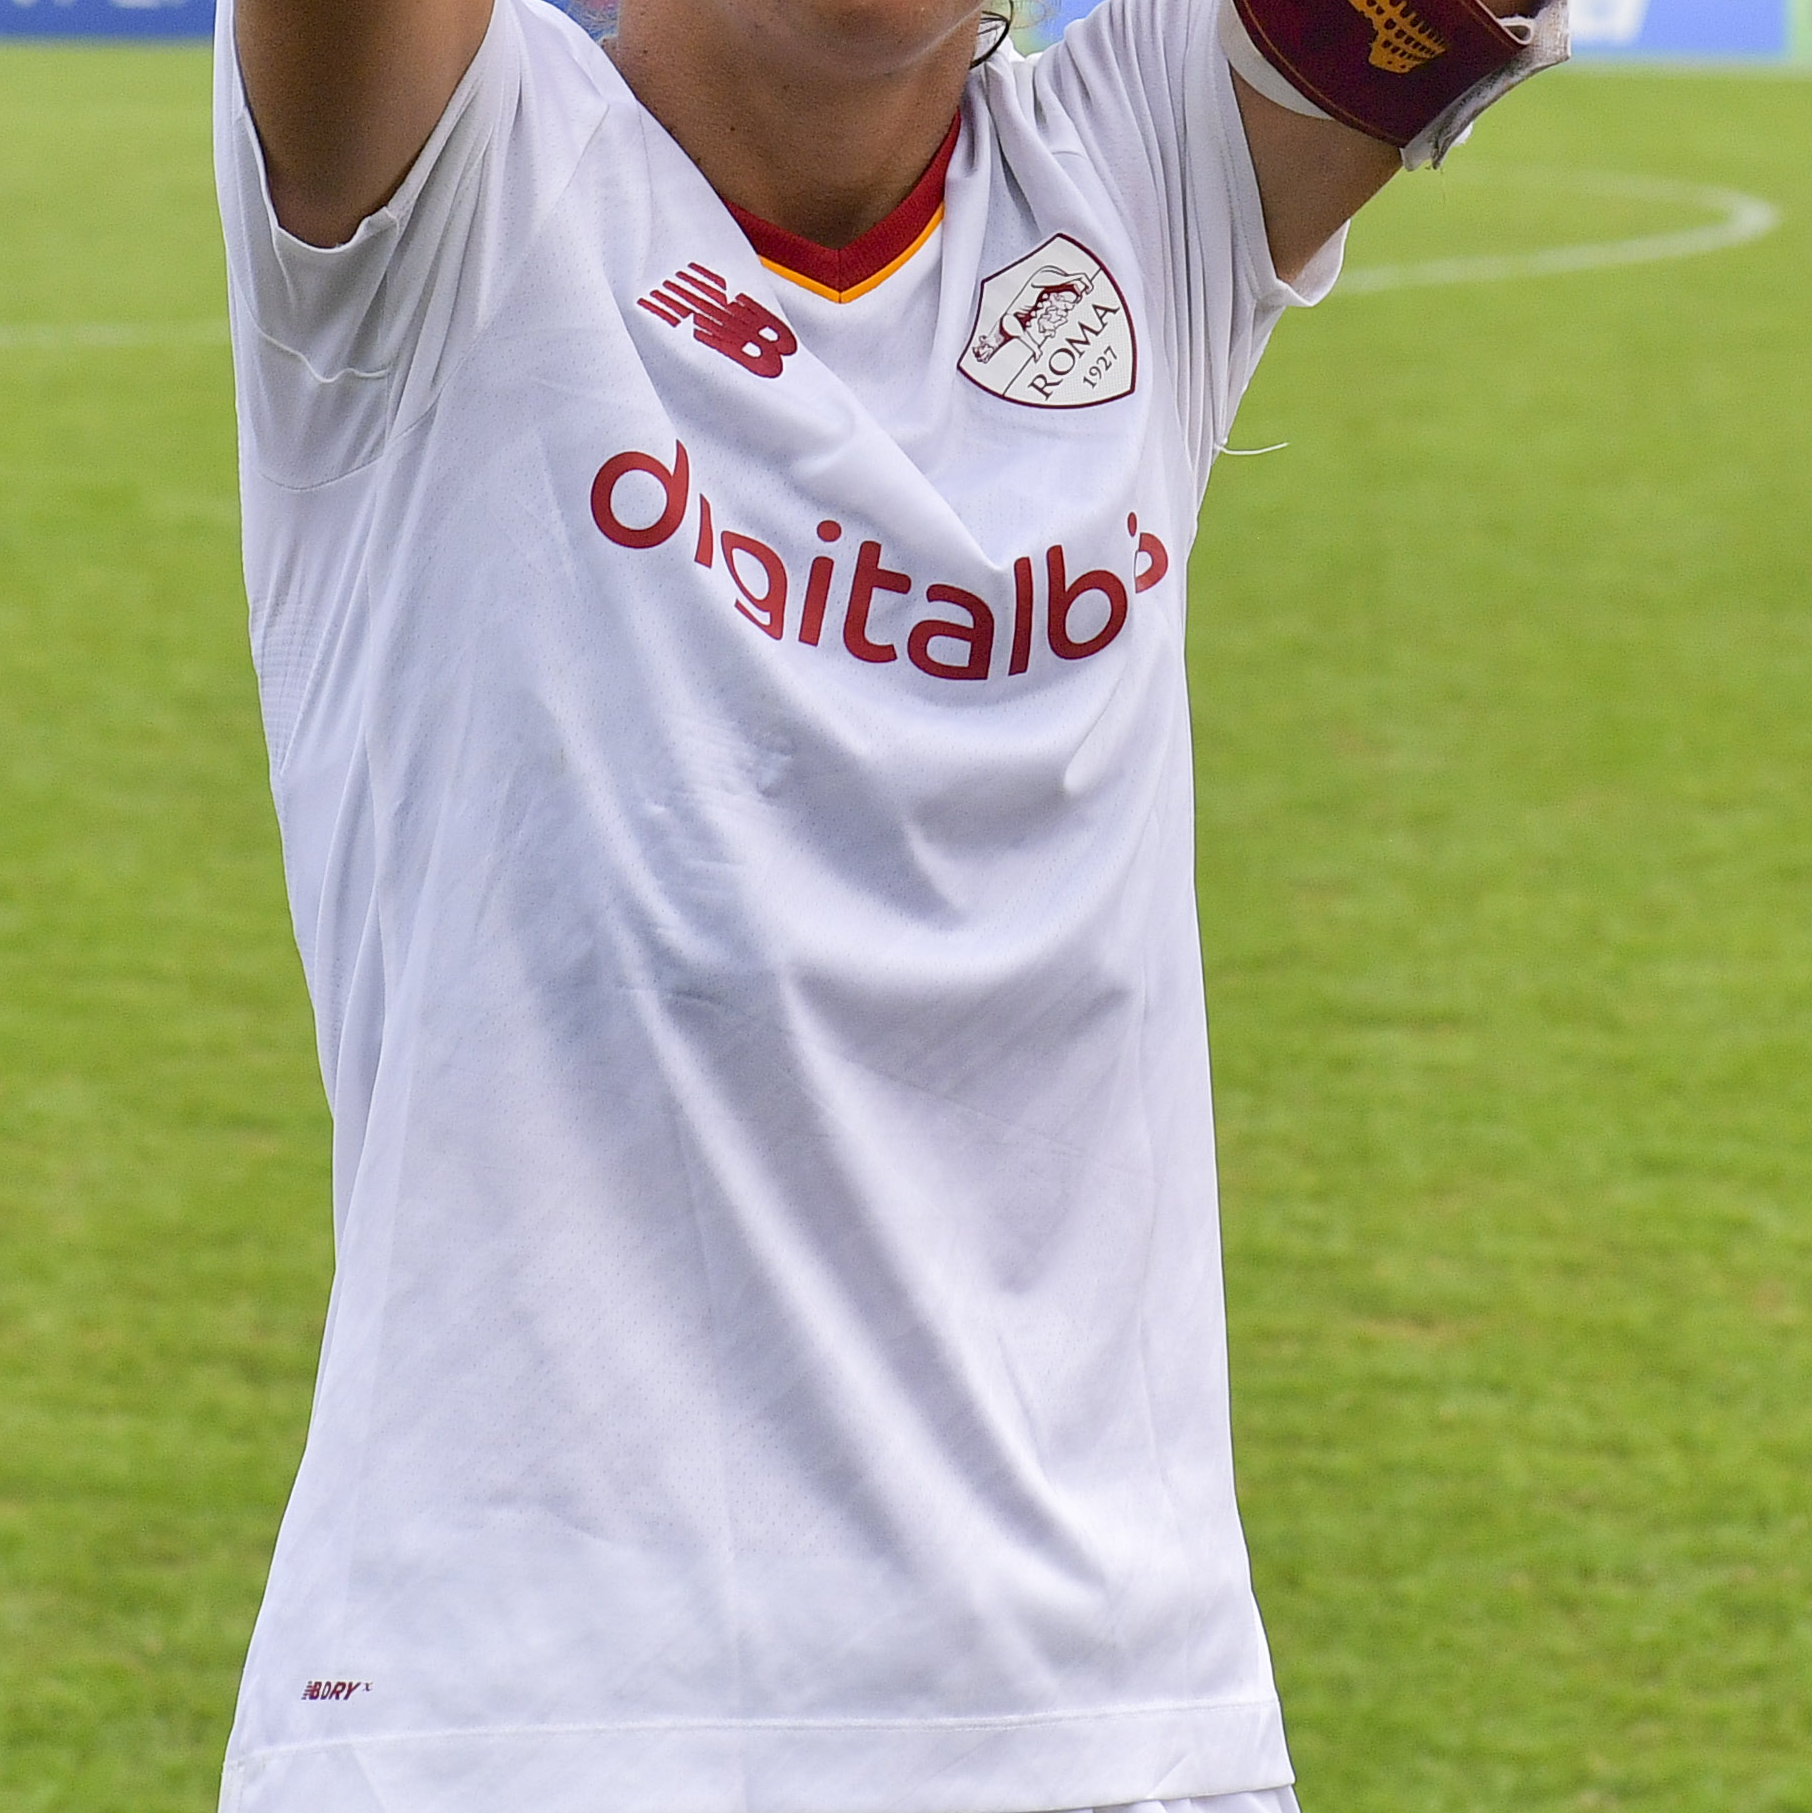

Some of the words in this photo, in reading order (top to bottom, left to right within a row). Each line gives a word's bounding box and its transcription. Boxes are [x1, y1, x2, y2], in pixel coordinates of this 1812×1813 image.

[1027, 303, 1121, 401] ROMA
[1082, 345, 1119, 389] 1927
[590, 439, 1169, 681] digitalb
